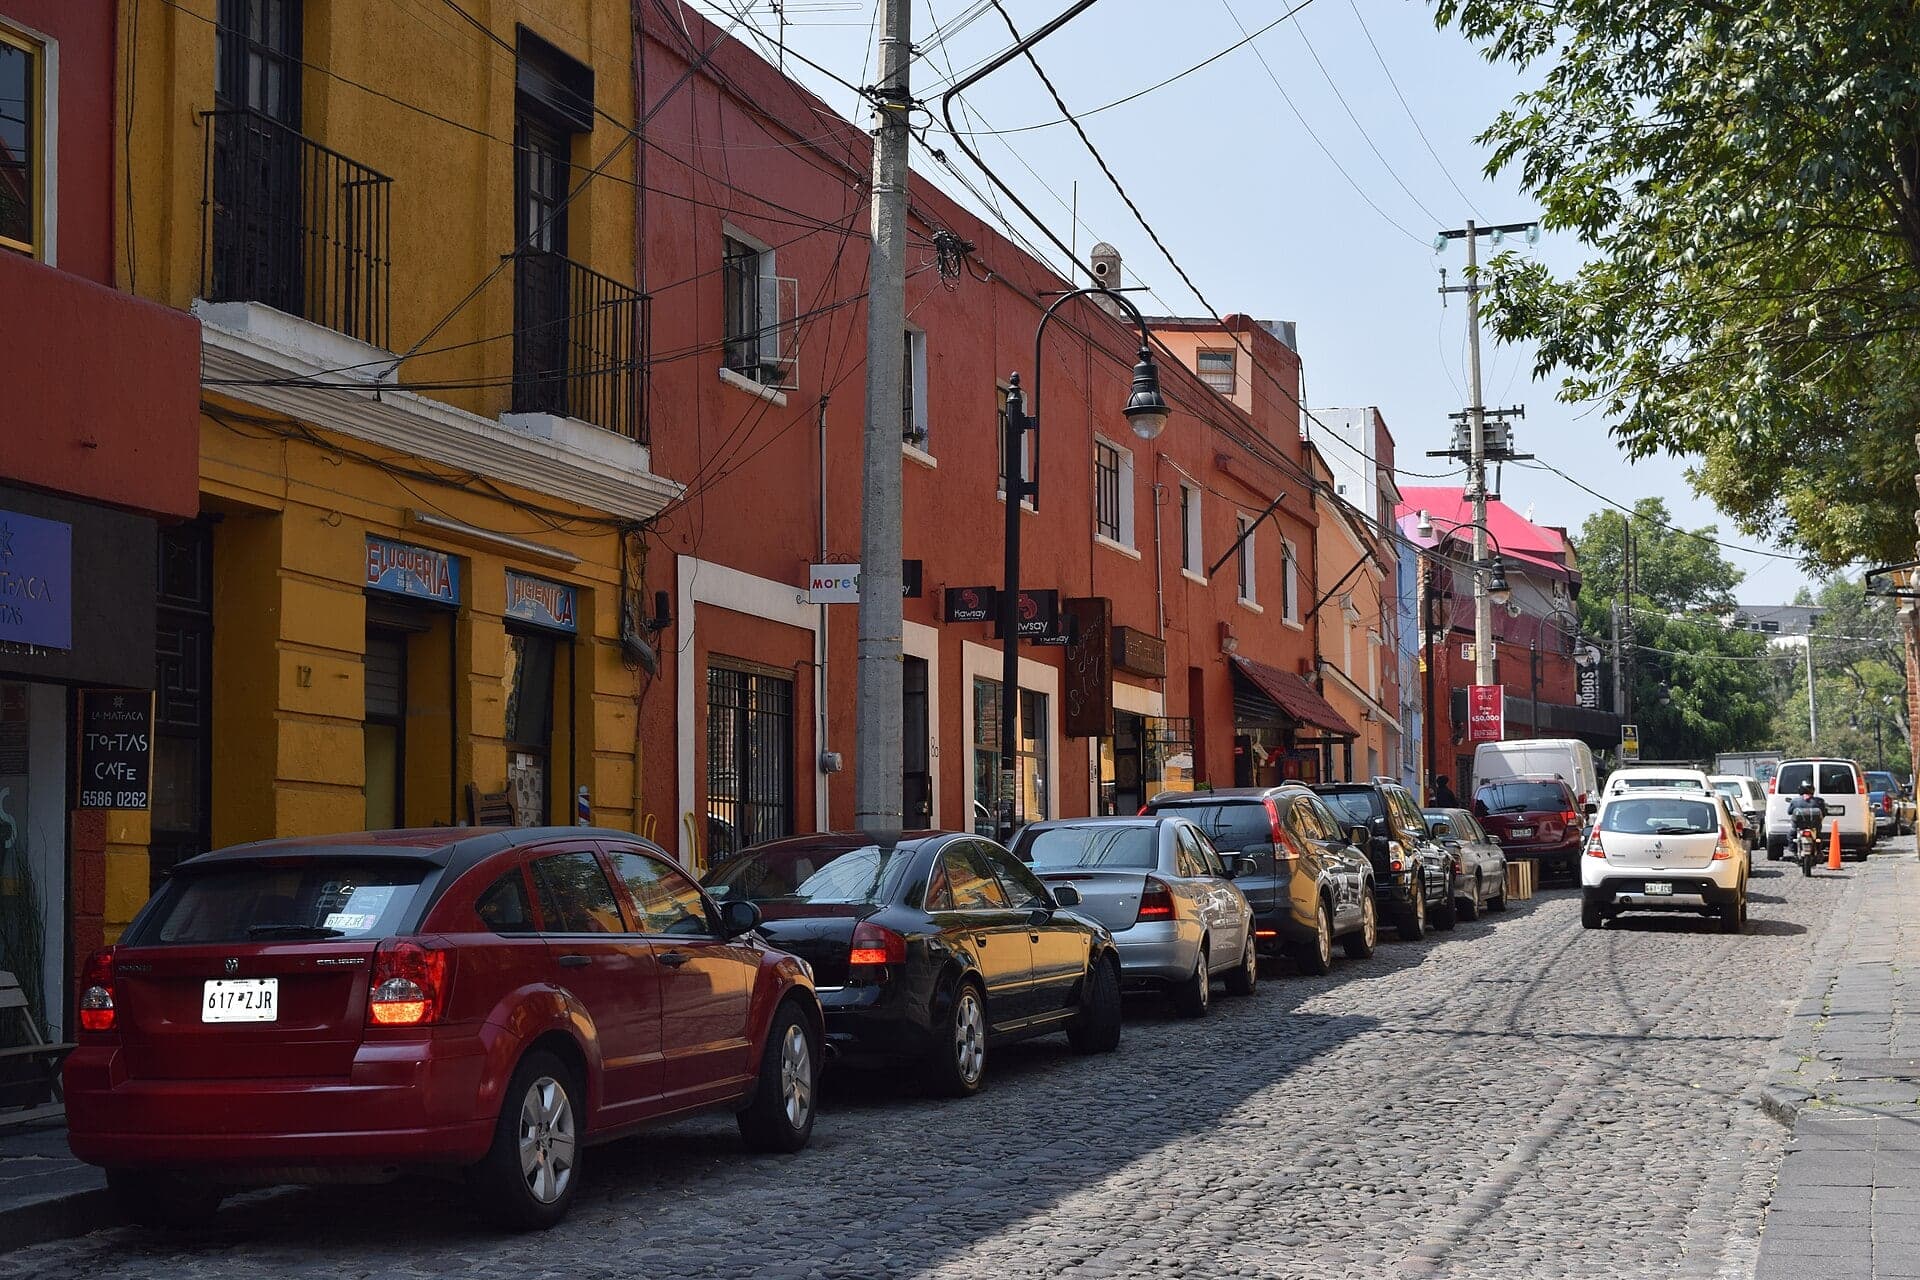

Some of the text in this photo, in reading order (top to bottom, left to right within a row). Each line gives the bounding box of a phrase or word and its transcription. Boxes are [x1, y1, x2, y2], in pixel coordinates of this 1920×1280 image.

[365, 543, 454, 599] ELUQUERIA
[954, 608, 986, 619] Kawsay
[1018, 621, 1048, 632] wsay
[1582, 671, 1595, 708] HOBOS
[82, 791, 147, 807] 5586 0262
